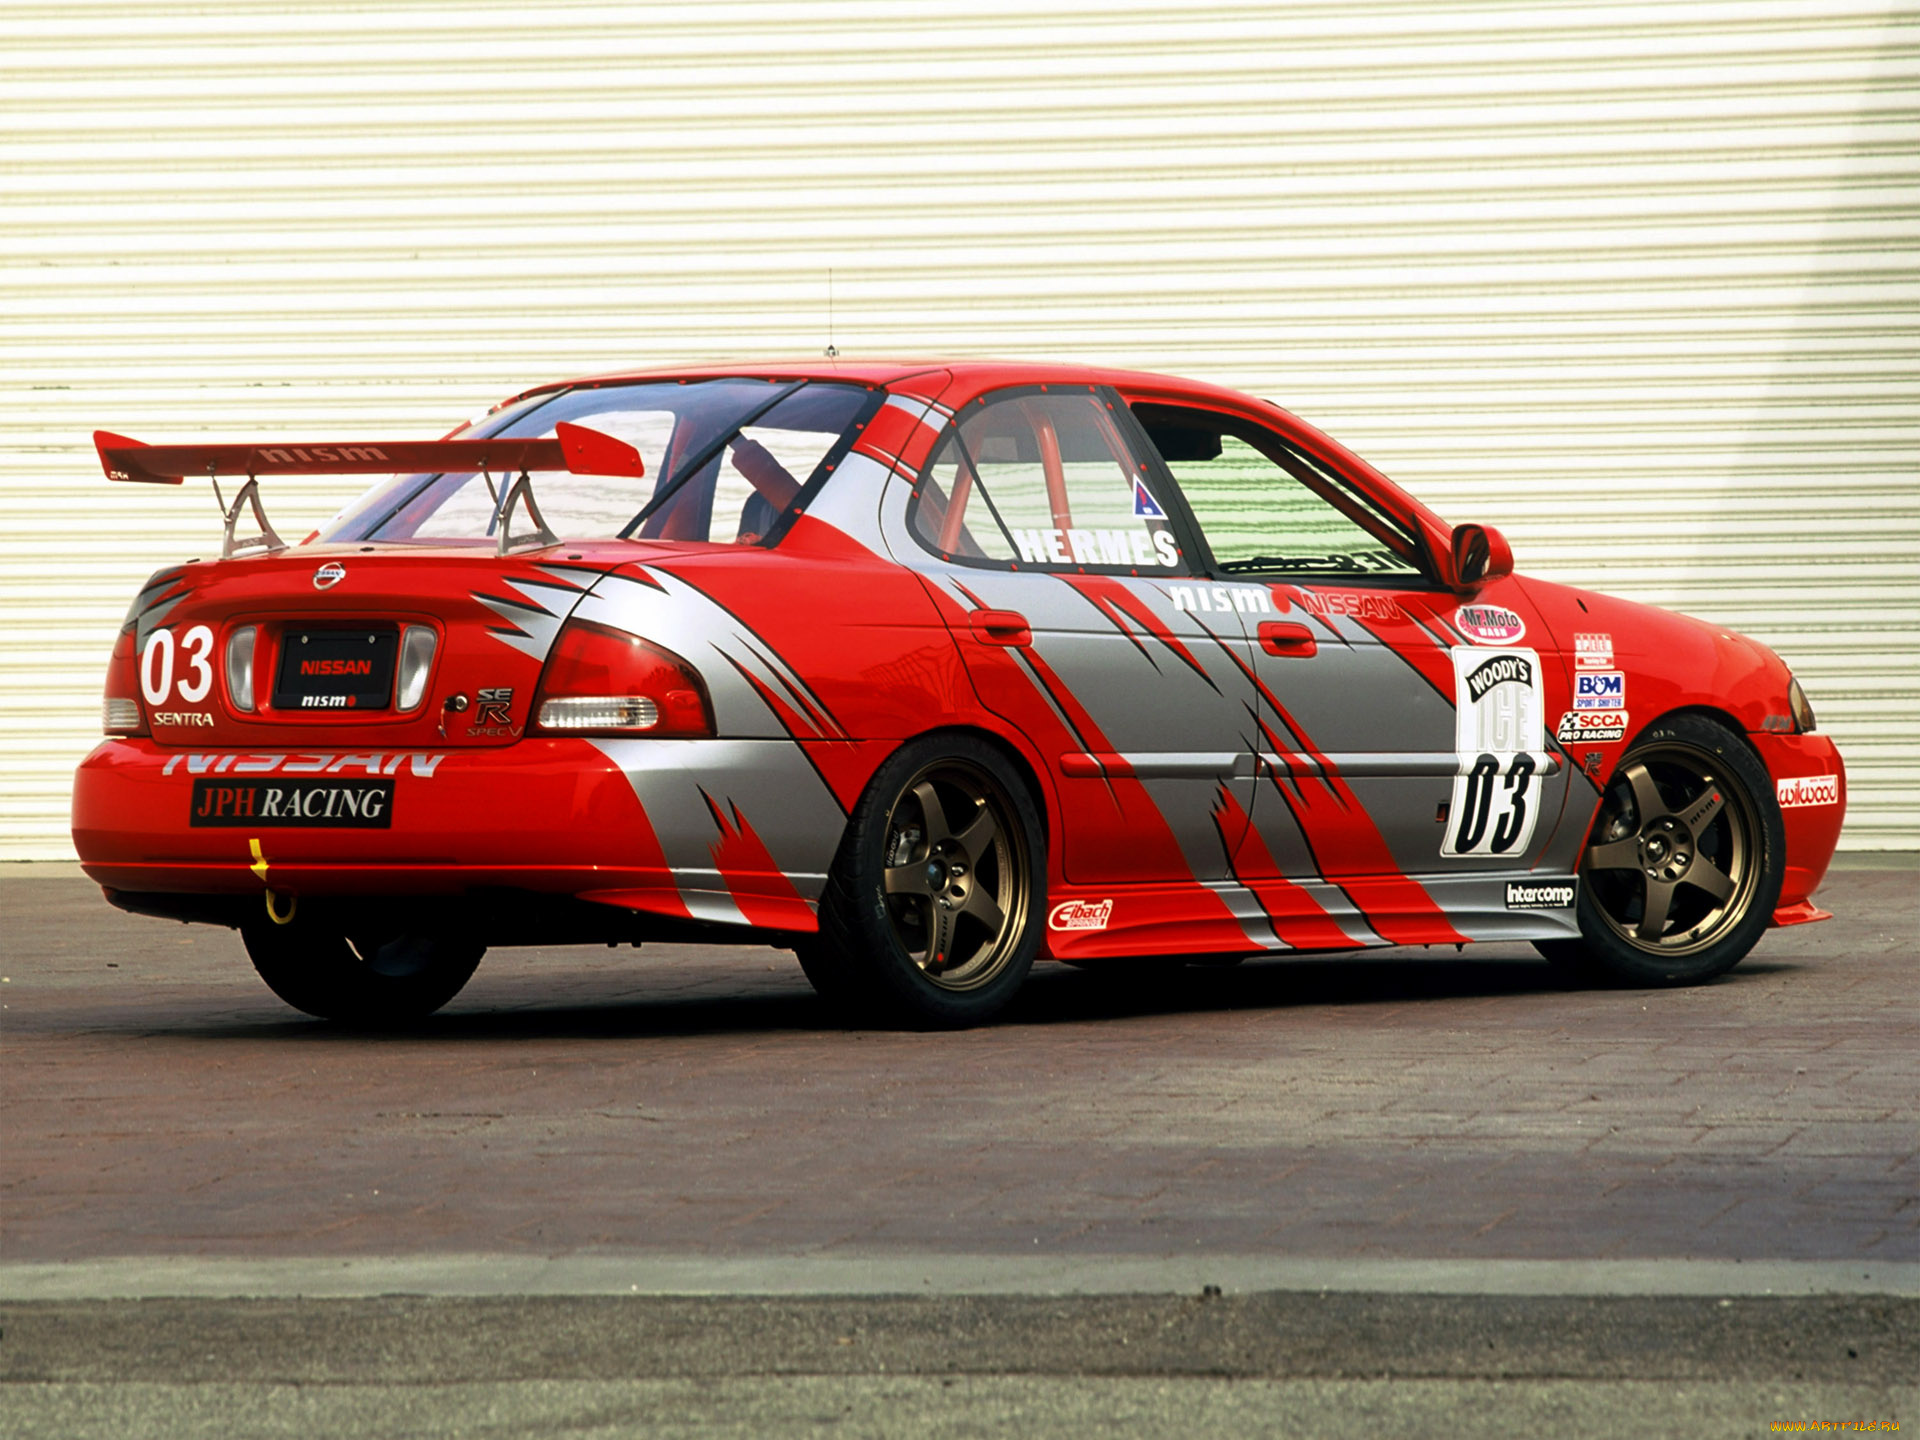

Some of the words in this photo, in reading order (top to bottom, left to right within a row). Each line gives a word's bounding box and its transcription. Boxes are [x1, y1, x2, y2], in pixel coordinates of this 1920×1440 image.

[1013, 528, 1179, 567] HERMES
[1301, 593, 1400, 619] NISSAN
[141, 625, 214, 706] 03
[301, 660, 371, 675] NISSAN
[1470, 658, 1528, 695] WOODY'S
[476, 688, 513, 701] SE
[1578, 676, 1621, 695] B&M
[475, 701, 512, 724] R
[1576, 699, 1596, 708] SPORT
[154, 712, 214, 727] SENTRA
[1477, 683, 1529, 751] ICE
[1579, 714, 1624, 727] SCCA
[466, 727, 508, 737] SPEC
[508, 726, 524, 737] V
[1559, 730, 1580, 741] PRO
[1582, 729, 1622, 740] RACING
[162, 752, 445, 777] NISSAN
[197, 787, 255, 817] JPH
[258, 788, 386, 818] RACING
[1455, 752, 1536, 853] 03
[1779, 780, 1837, 806] wilwood
[1507, 883, 1574, 907] Intercomp
